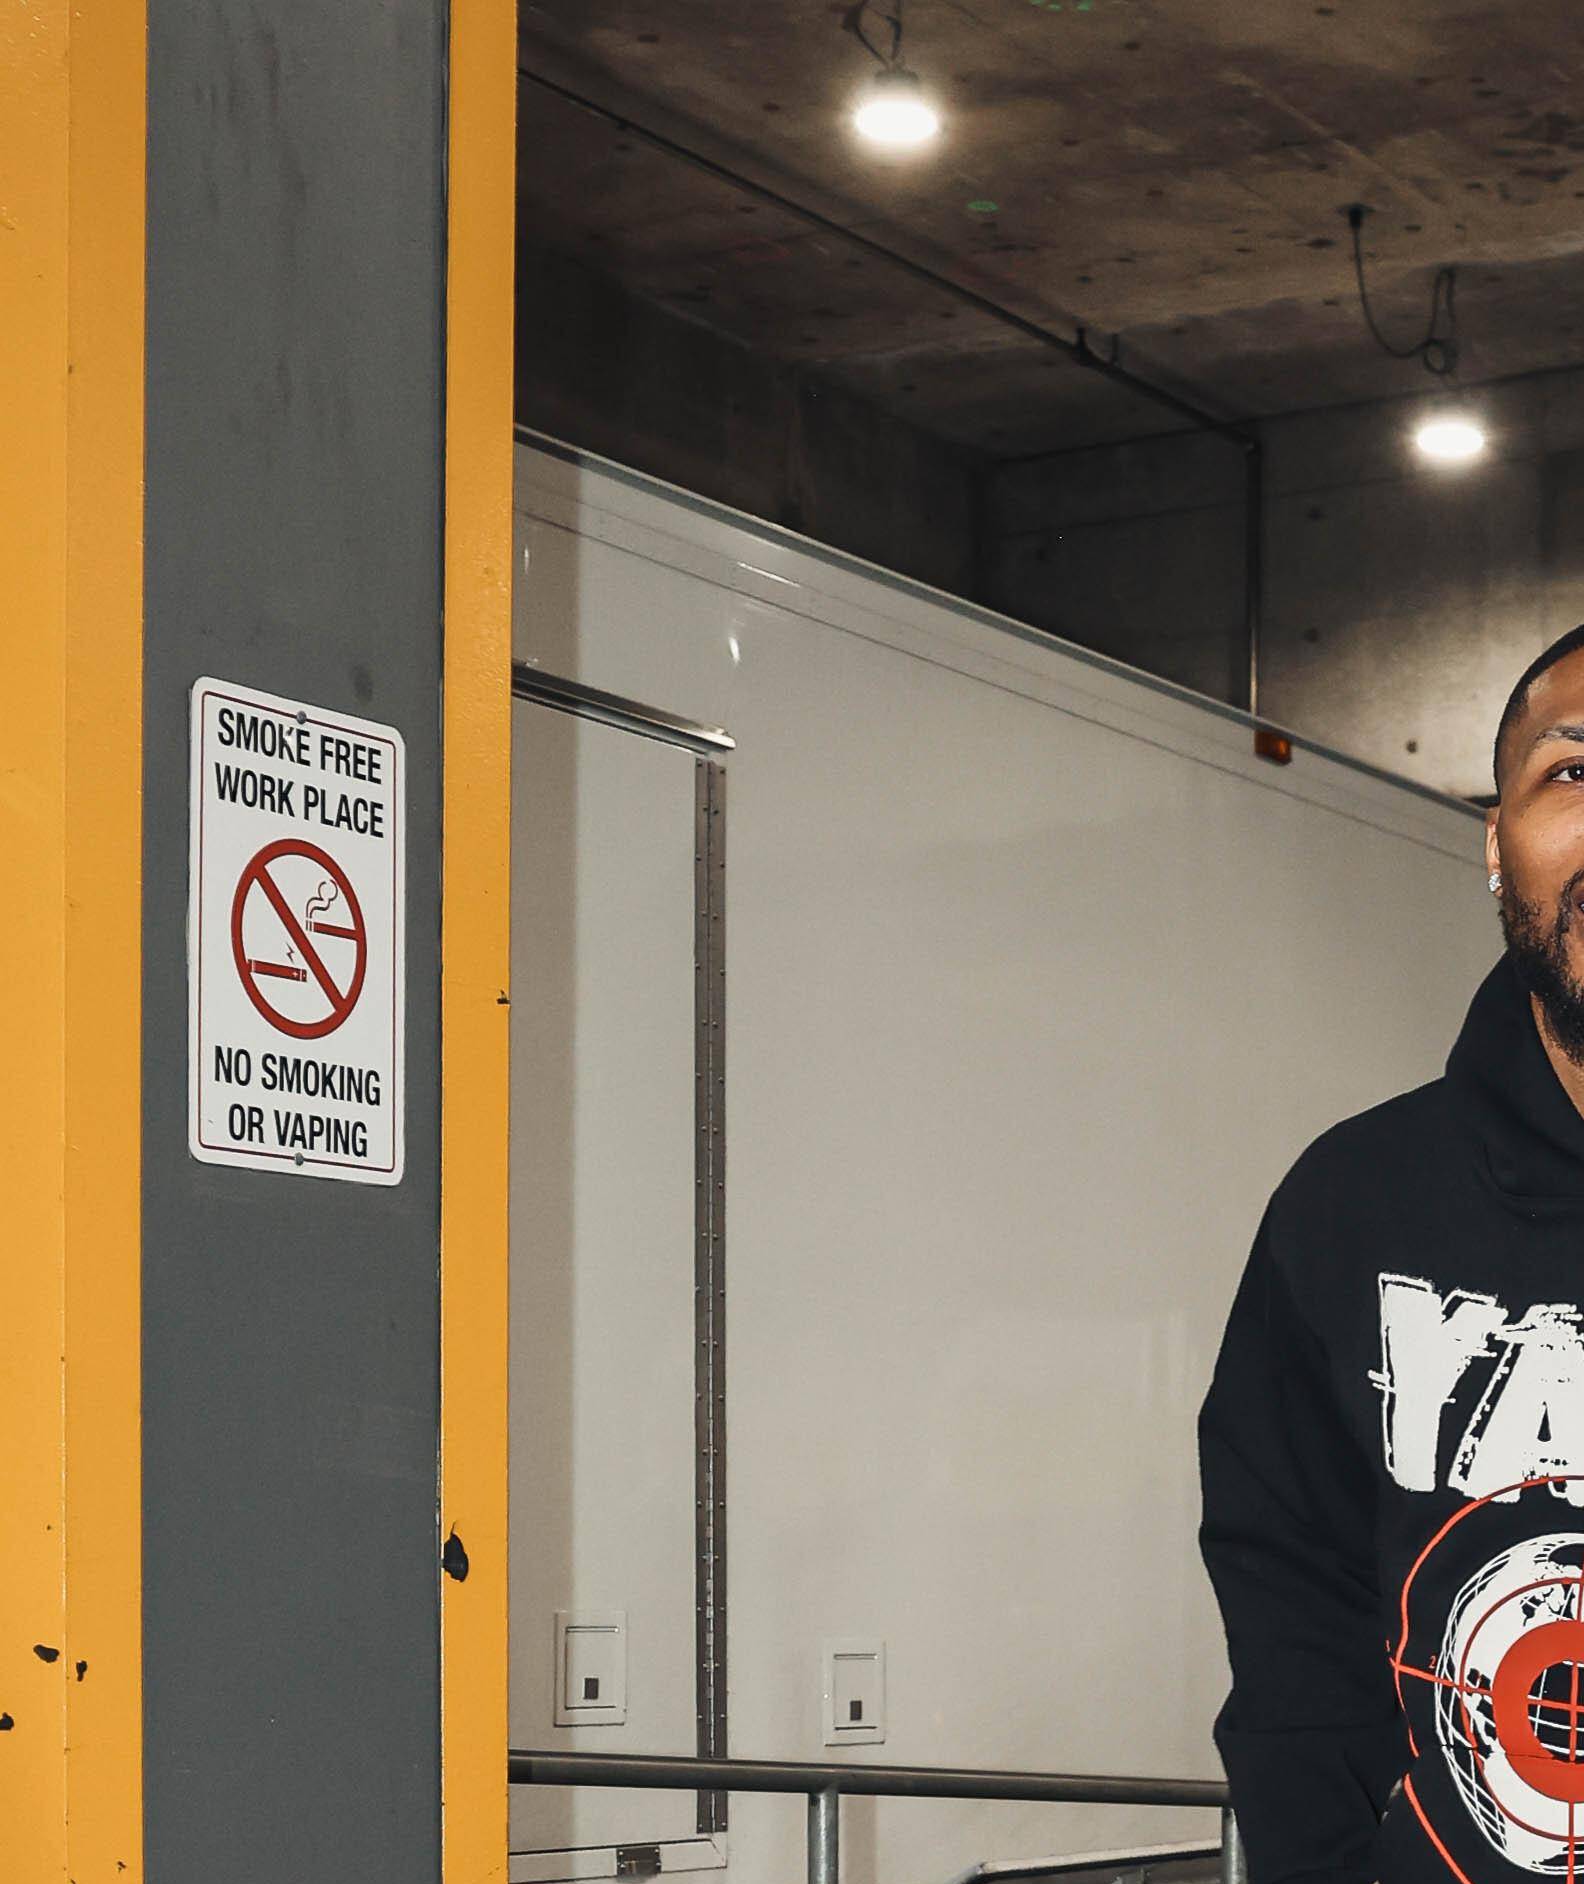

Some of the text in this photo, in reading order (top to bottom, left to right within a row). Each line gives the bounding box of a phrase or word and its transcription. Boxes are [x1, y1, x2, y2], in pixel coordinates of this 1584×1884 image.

[218, 708, 382, 785] SMOKE FREE
[215, 763, 384, 839] WORK PLACE
[215, 1046, 381, 1106] NO SMOKING
[229, 1104, 368, 1158] OR VAPING
